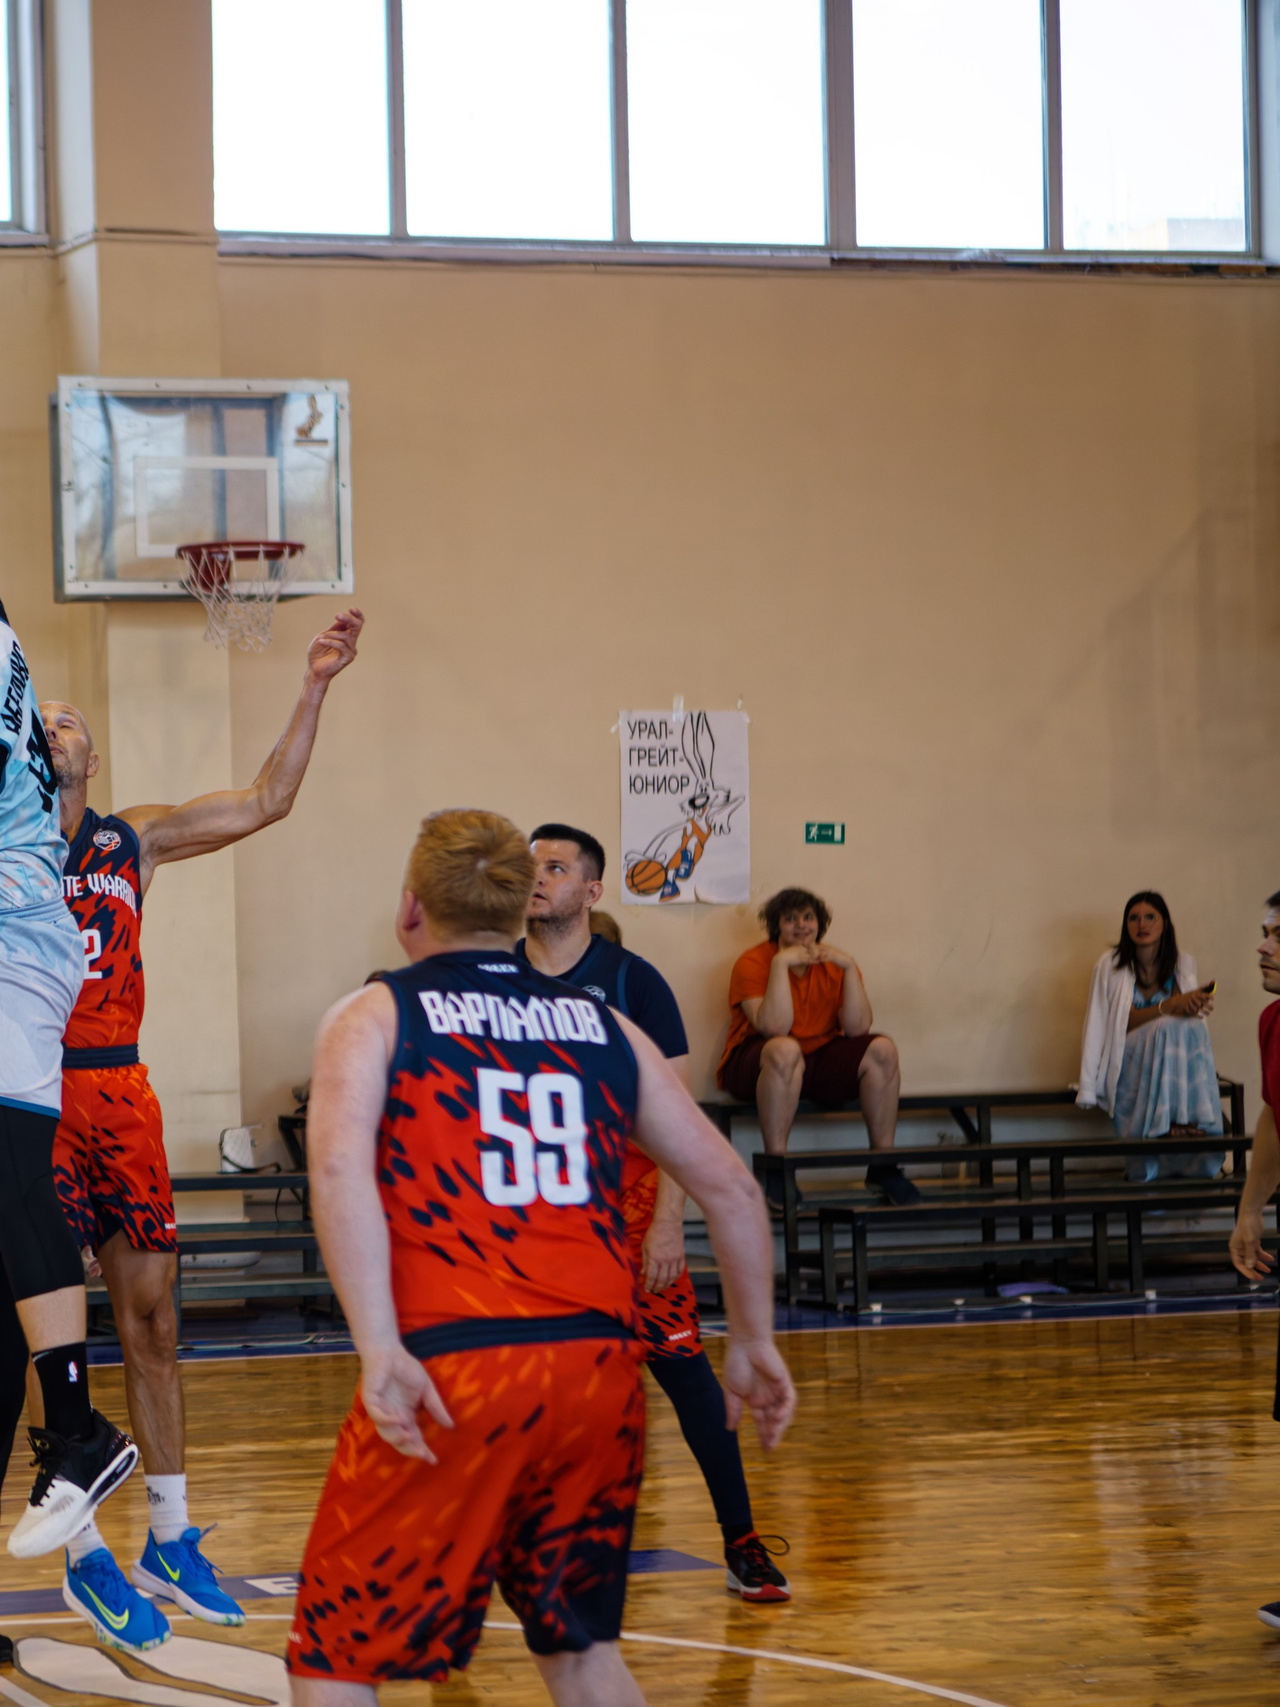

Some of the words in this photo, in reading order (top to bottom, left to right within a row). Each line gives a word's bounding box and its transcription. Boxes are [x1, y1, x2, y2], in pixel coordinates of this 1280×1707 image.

[627, 720, 673, 741] УРАЛ-
[629, 743, 684, 768] ГРЕЙТ-
[629, 775, 690, 795] ЮНИОР
[477, 1068, 591, 1207] 59
